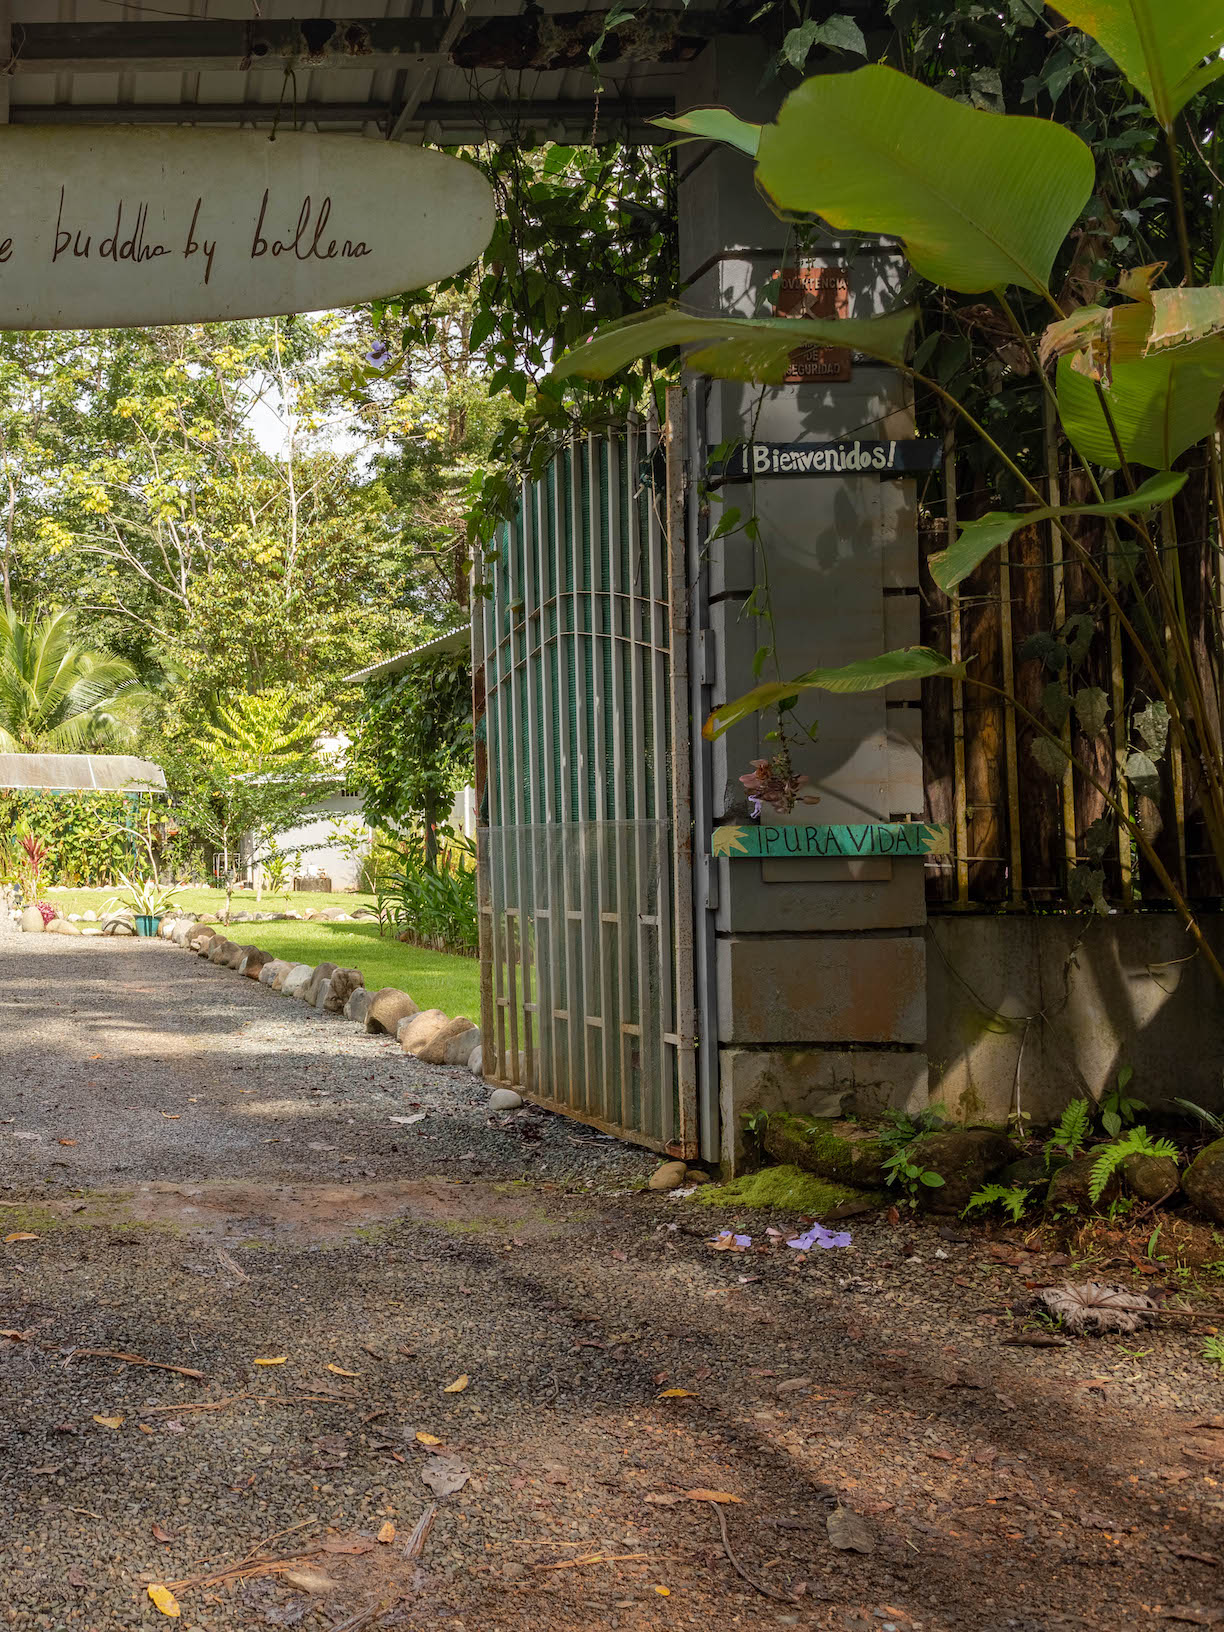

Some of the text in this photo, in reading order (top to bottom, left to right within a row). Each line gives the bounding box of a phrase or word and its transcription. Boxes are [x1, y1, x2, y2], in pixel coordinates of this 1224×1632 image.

[52, 184, 172, 264] buddha
[182, 197, 217, 285] by
[251, 188, 373, 260] ballena
[782, 278, 848, 290] DVERTENCIA
[787, 363, 841, 376] SEGURIDAD
[846, 825, 920, 854] VIDA!
